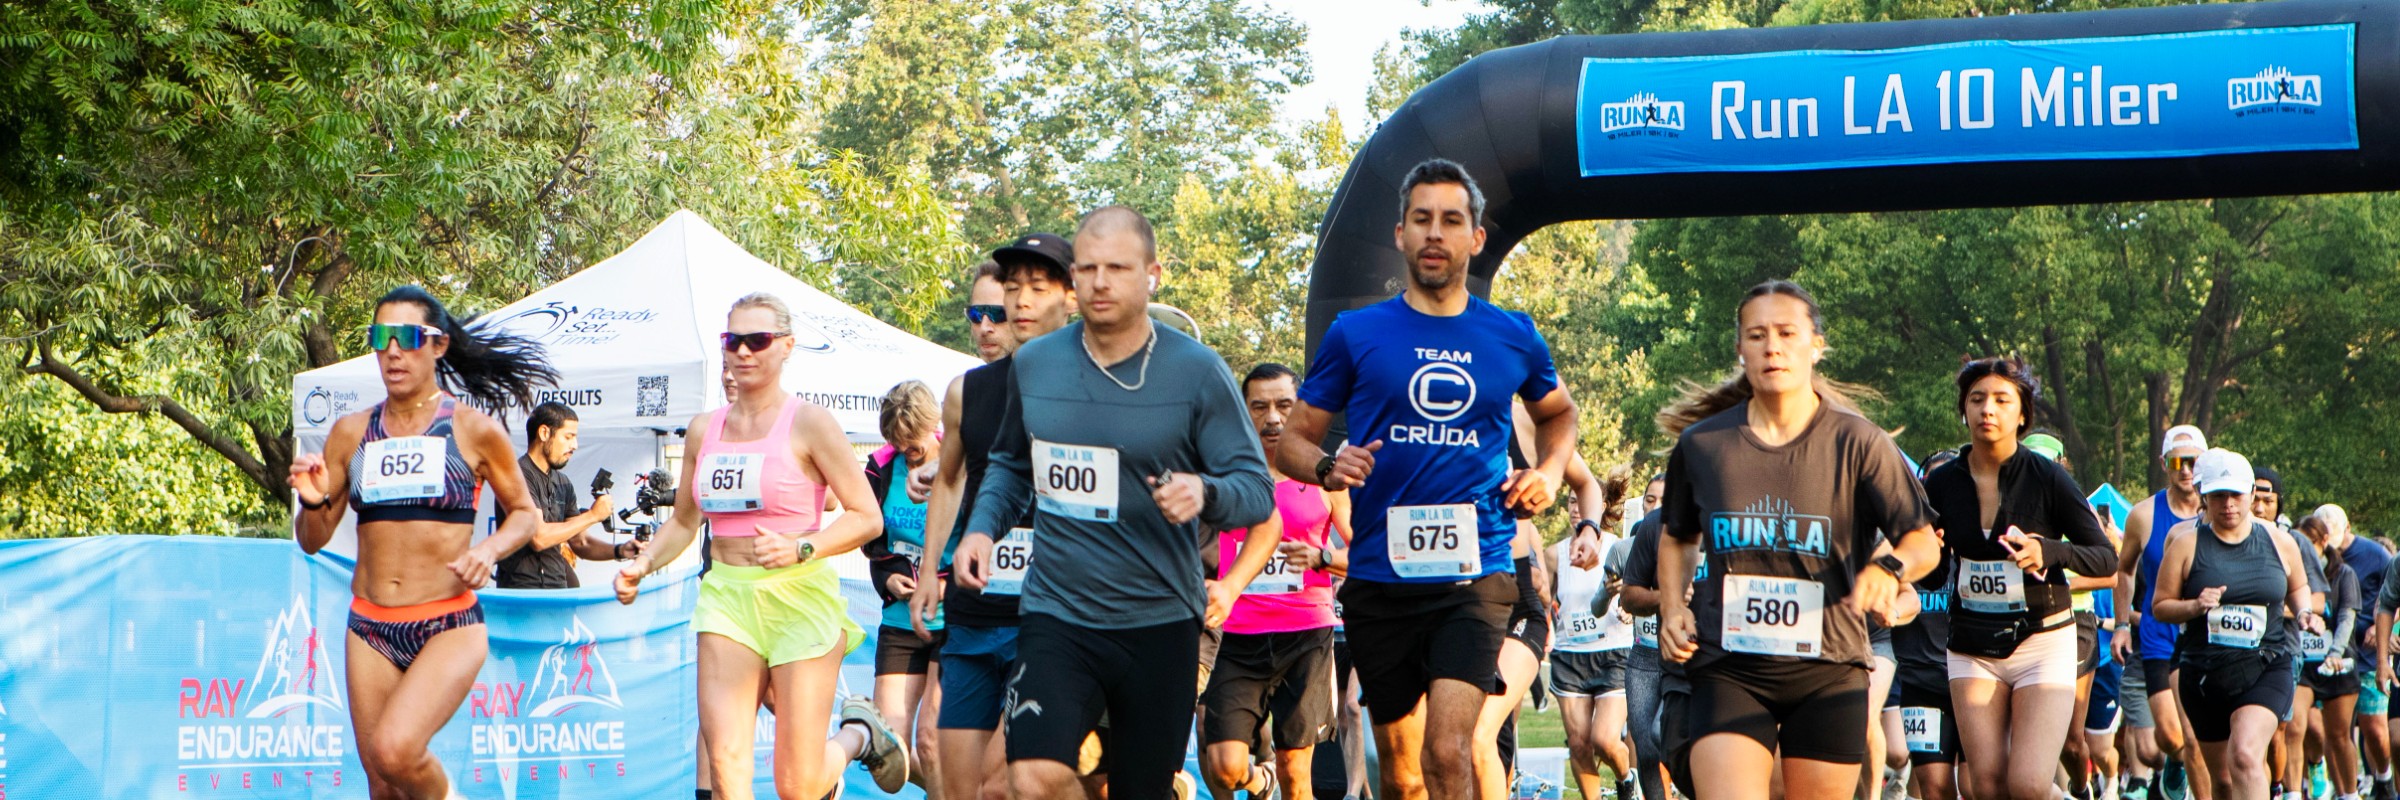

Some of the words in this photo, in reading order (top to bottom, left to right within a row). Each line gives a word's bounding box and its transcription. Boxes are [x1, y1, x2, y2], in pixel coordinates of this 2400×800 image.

[1711, 80, 1818, 139] Run
[1844, 74, 1912, 135] LA
[1936, 68, 1994, 130] 10
[2022, 65, 2177, 127] Miler
[2232, 81, 2281, 105] RUN
[2290, 79, 2317, 102] LA
[1605, 104, 1648, 128] RUN
[1656, 105, 1681, 126] LA
[581, 307, 659, 323] Ready,
[551, 333, 620, 345] Time!
[1414, 347, 1472, 364] TEAM
[1419, 372, 1465, 411] C
[1390, 423, 1480, 448] CRÜDA
[380, 453, 425, 477] 652
[711, 468, 744, 490] 651
[1048, 463, 1097, 494] 600
[1409, 509, 1427, 521] RUN
[1428, 509, 1440, 520] LA
[1408, 524, 1459, 552] 675
[1713, 517, 1777, 550] RUN
[1785, 519, 1826, 555] LA
[1264, 555, 1288, 576] 87
[1749, 579, 1767, 594] RUN
[1769, 581, 1780, 594] LA
[1969, 574, 2007, 595] 605
[1745, 597, 1800, 627] 580
[2220, 614, 2253, 631] 630
[1573, 617, 1597, 633] 513
[2302, 638, 2325, 651] 538
[180, 678, 245, 718] RAY
[471, 682, 526, 718] RAY
[471, 721, 625, 755] ENDURANCE
[1903, 718, 1927, 735] 644
[178, 725, 343, 759] ENDURANCE
[178, 770, 342, 791] EVENTS
[474, 762, 626, 783] EVENTS
